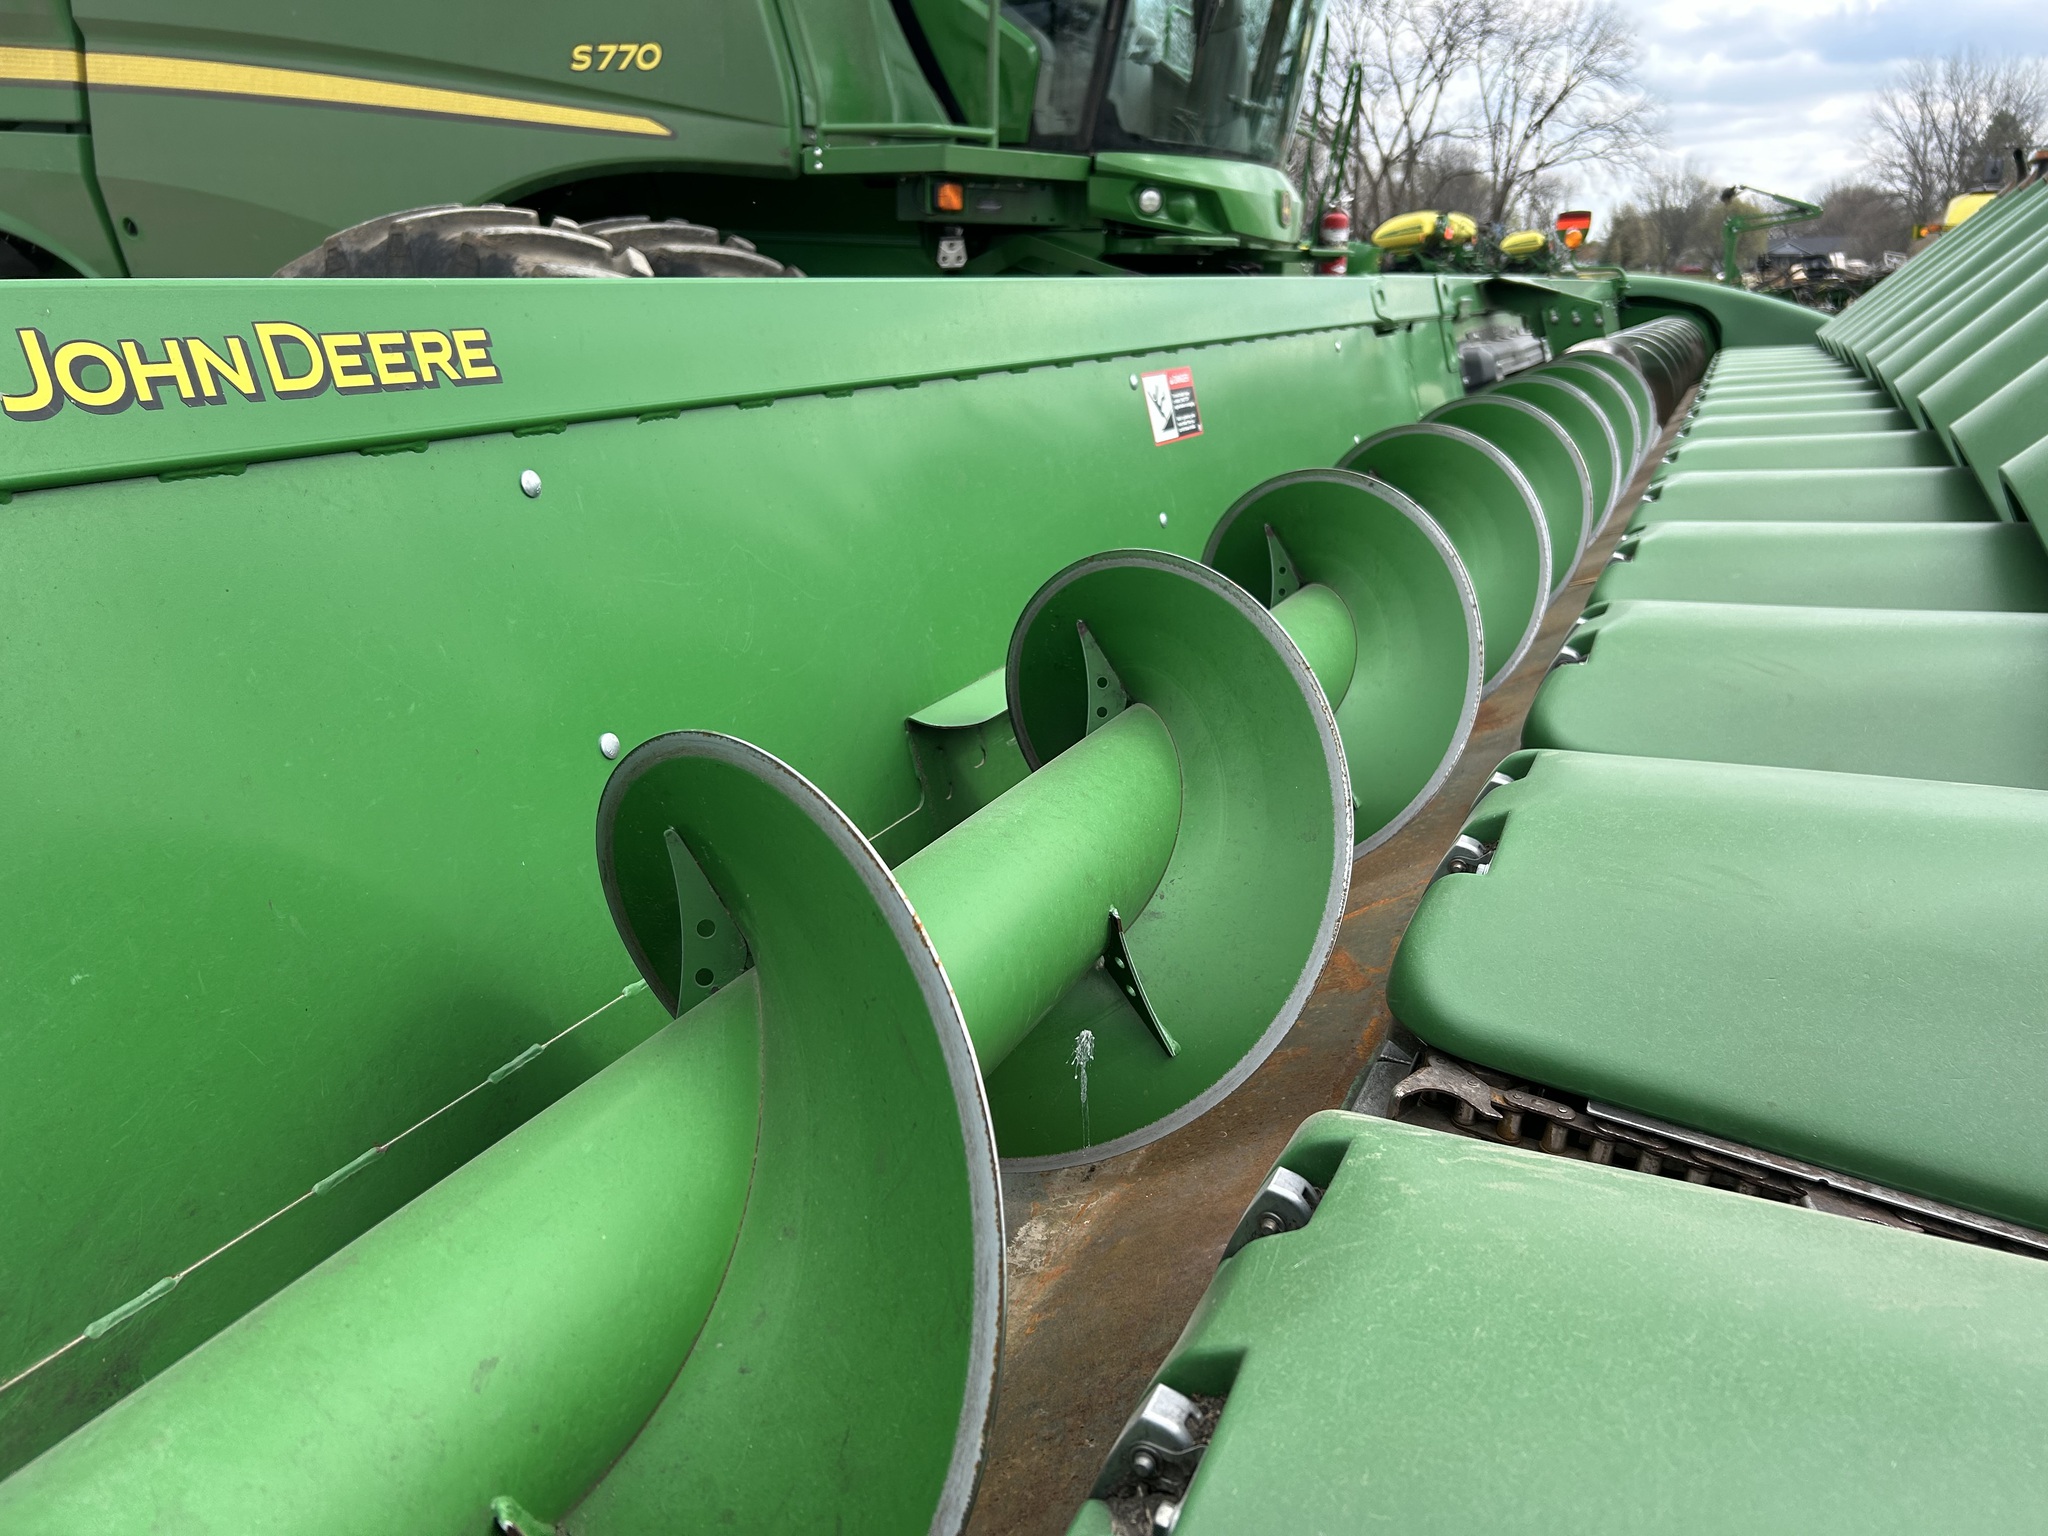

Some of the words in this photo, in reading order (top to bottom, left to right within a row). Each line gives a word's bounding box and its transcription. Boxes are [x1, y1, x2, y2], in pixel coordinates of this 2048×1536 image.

[570, 42, 663, 72] S770
[1, 328, 262, 419] JOHN
[253, 321, 500, 398] DEERE
